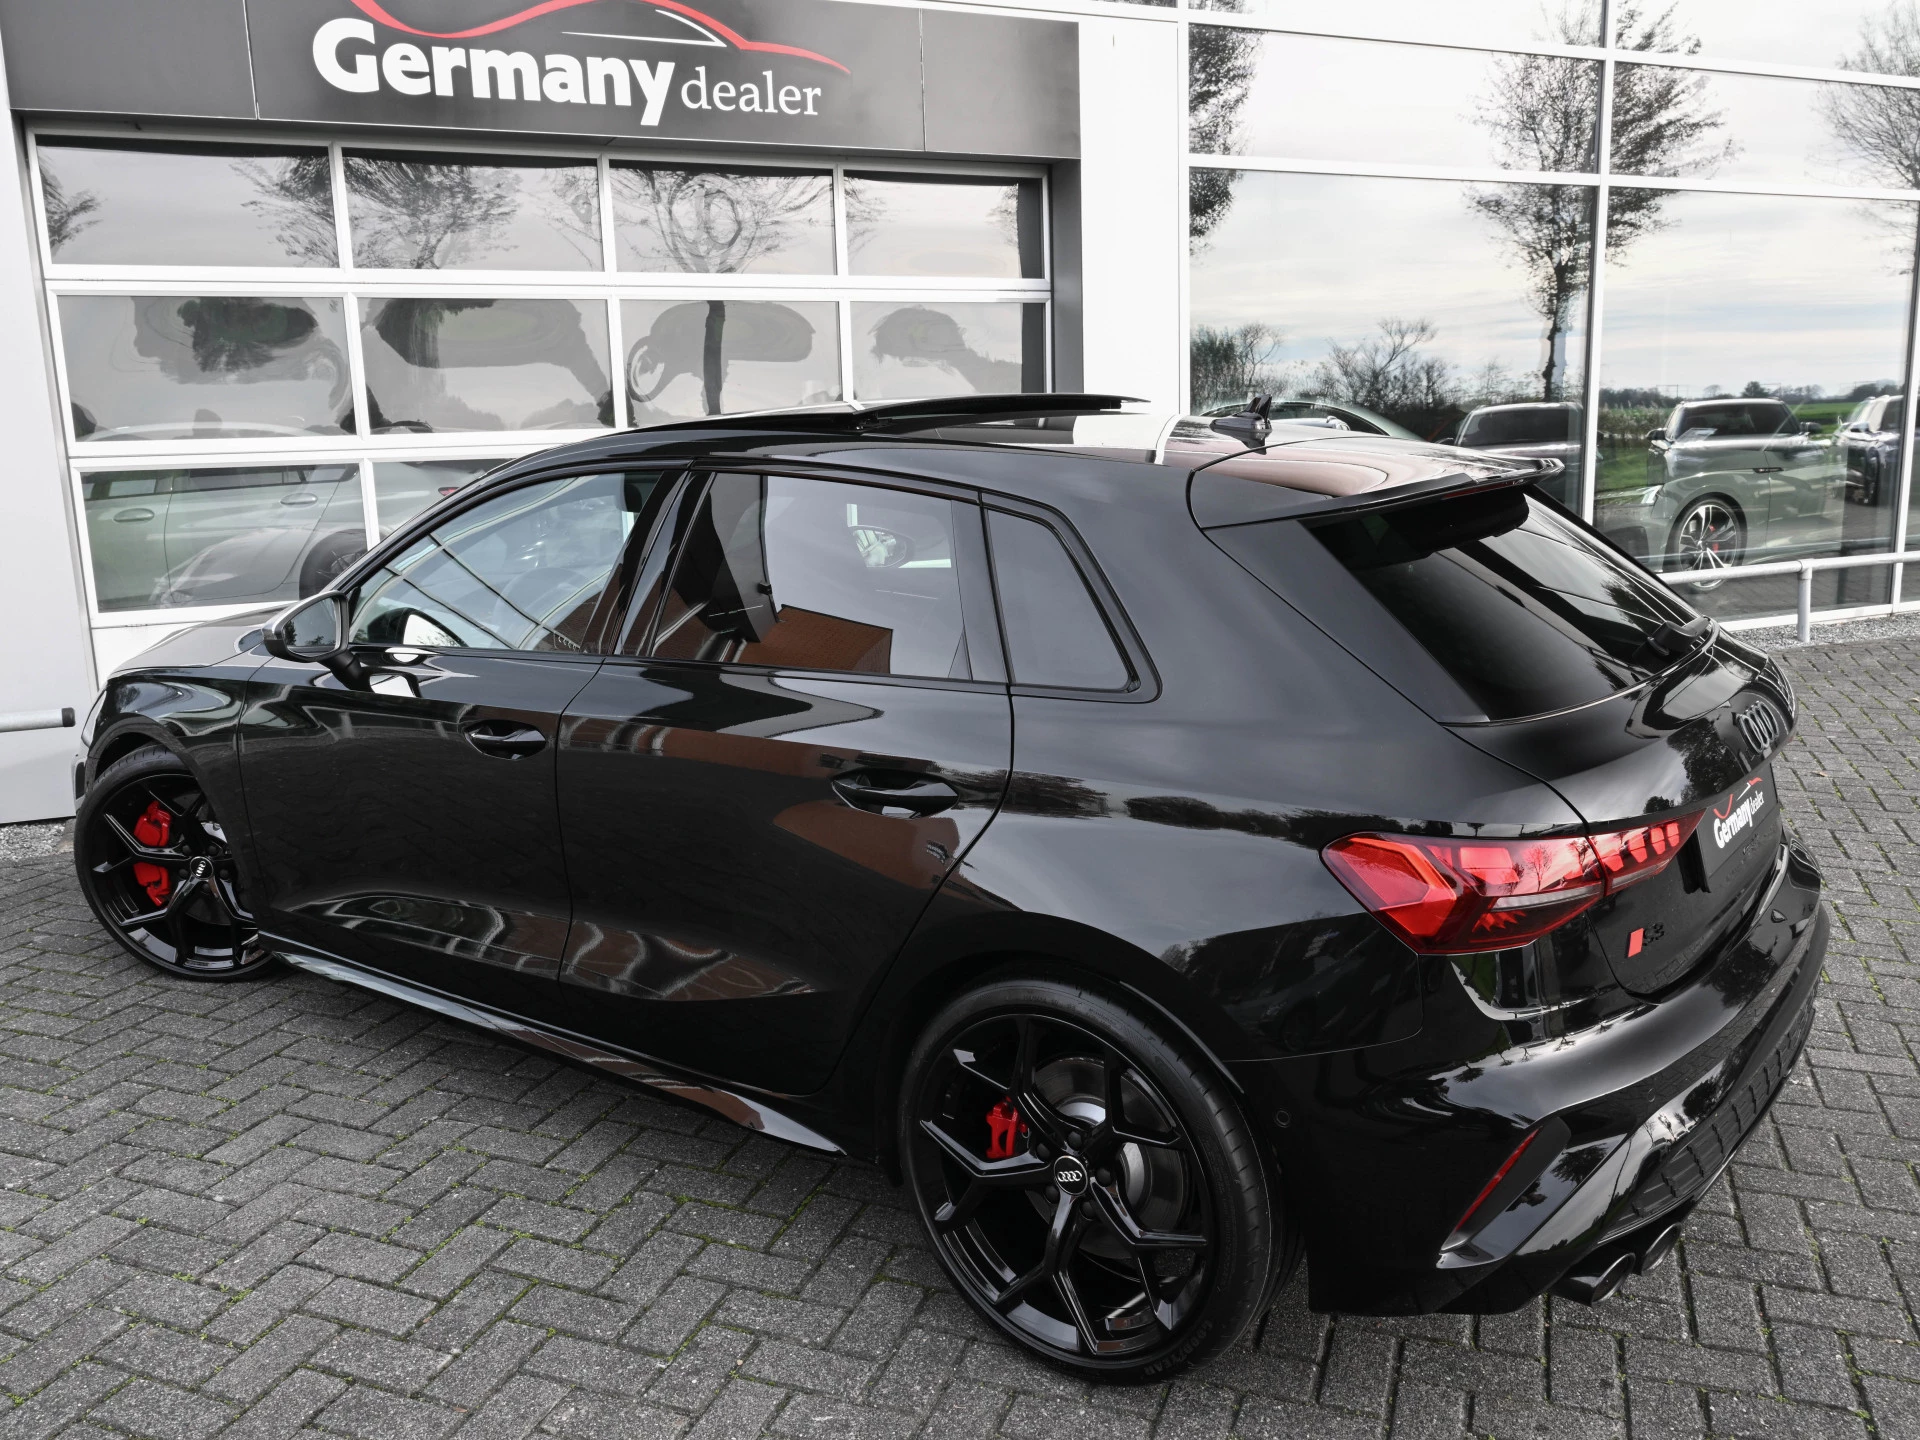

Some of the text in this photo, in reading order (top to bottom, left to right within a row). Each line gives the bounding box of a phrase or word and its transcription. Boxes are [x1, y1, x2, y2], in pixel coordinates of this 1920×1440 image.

[313, 17, 822, 126] Germany dealer
[1713, 790, 1765, 849] Germany dealer
